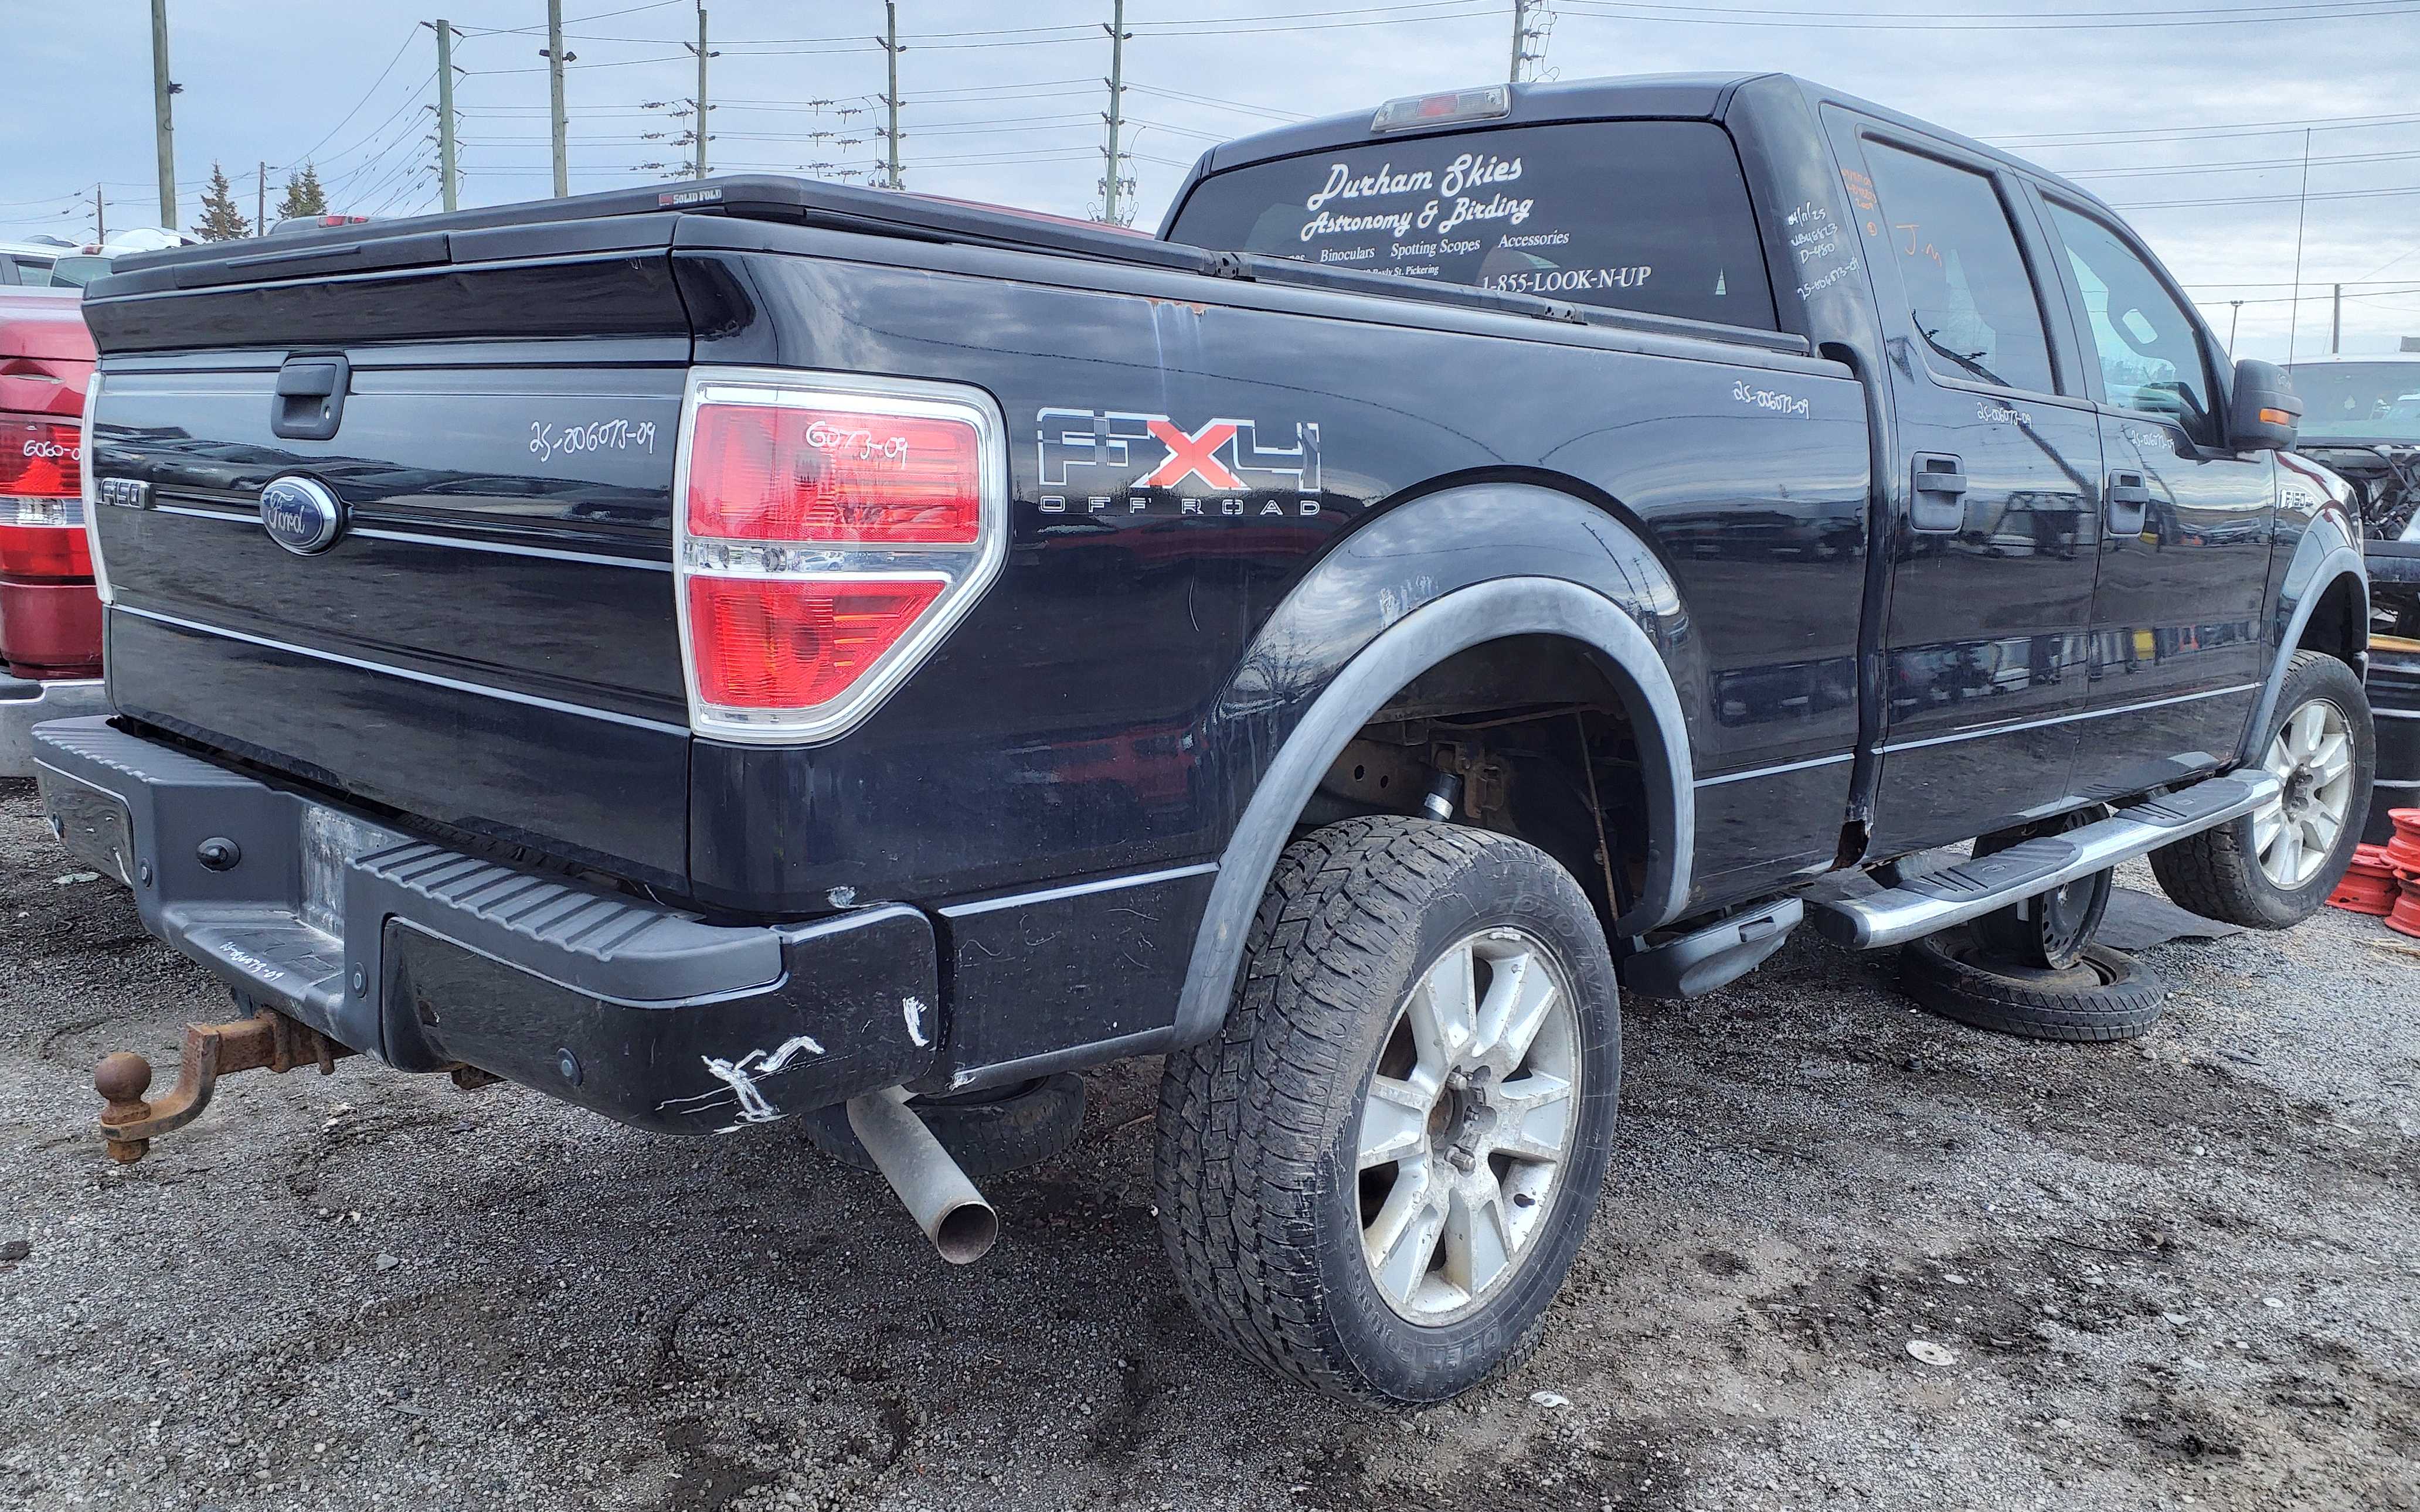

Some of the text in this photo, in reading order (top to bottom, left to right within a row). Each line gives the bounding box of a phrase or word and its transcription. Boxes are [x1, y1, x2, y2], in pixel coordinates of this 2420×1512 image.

[673, 192, 698, 205] SOLID
[699, 189, 722, 201] FOLD
[1307, 154, 1523, 211] Durham Skies
[1301, 193, 1534, 241] Astronomy & Birding
[1320, 246, 1376, 263] Binoculars
[1391, 240, 1437, 260] Spotting
[1439, 237, 1481, 255] Scopes
[1497, 229, 1570, 248] Accessories
[1406, 264, 1440, 276] Pickering
[1482, 265, 1652, 294] 1-855-LOOK-N-UP
[807, 421, 908, 469] 6073-09
[1036, 406, 1322, 492] FX4
[268, 491, 307, 535] Ford
[1039, 495, 1321, 516] OFF ROAD
